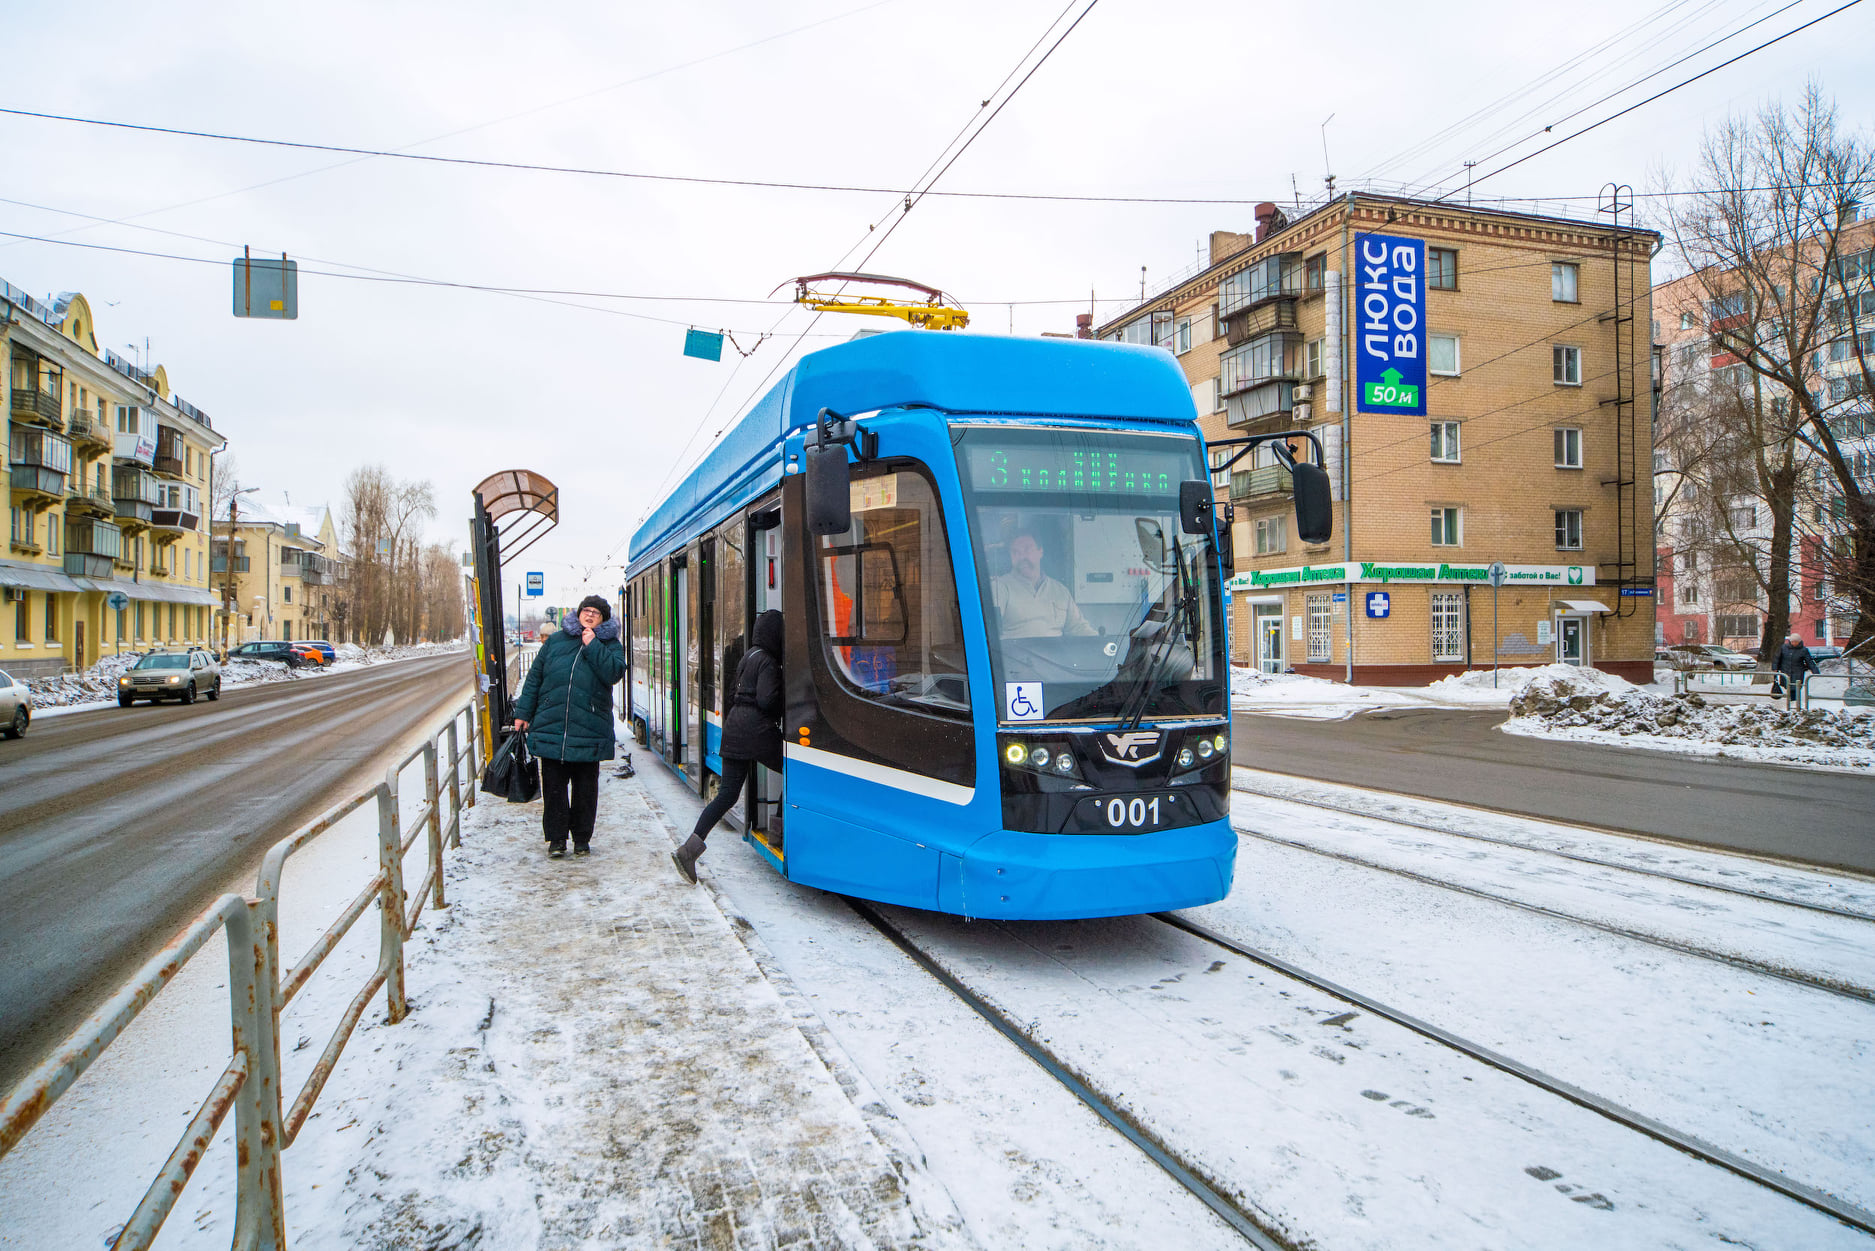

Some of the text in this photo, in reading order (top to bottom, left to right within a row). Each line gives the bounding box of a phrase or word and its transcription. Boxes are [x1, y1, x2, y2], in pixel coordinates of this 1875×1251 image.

[1372, 385, 1397, 403] 50
[1302, 566, 1346, 582] Аптека
[1360, 562, 1436, 583] Хорошая
[1510, 571, 1538, 580] заботой
[1545, 571, 1561, 580] Вас!
[1107, 797, 1160, 827] 001
